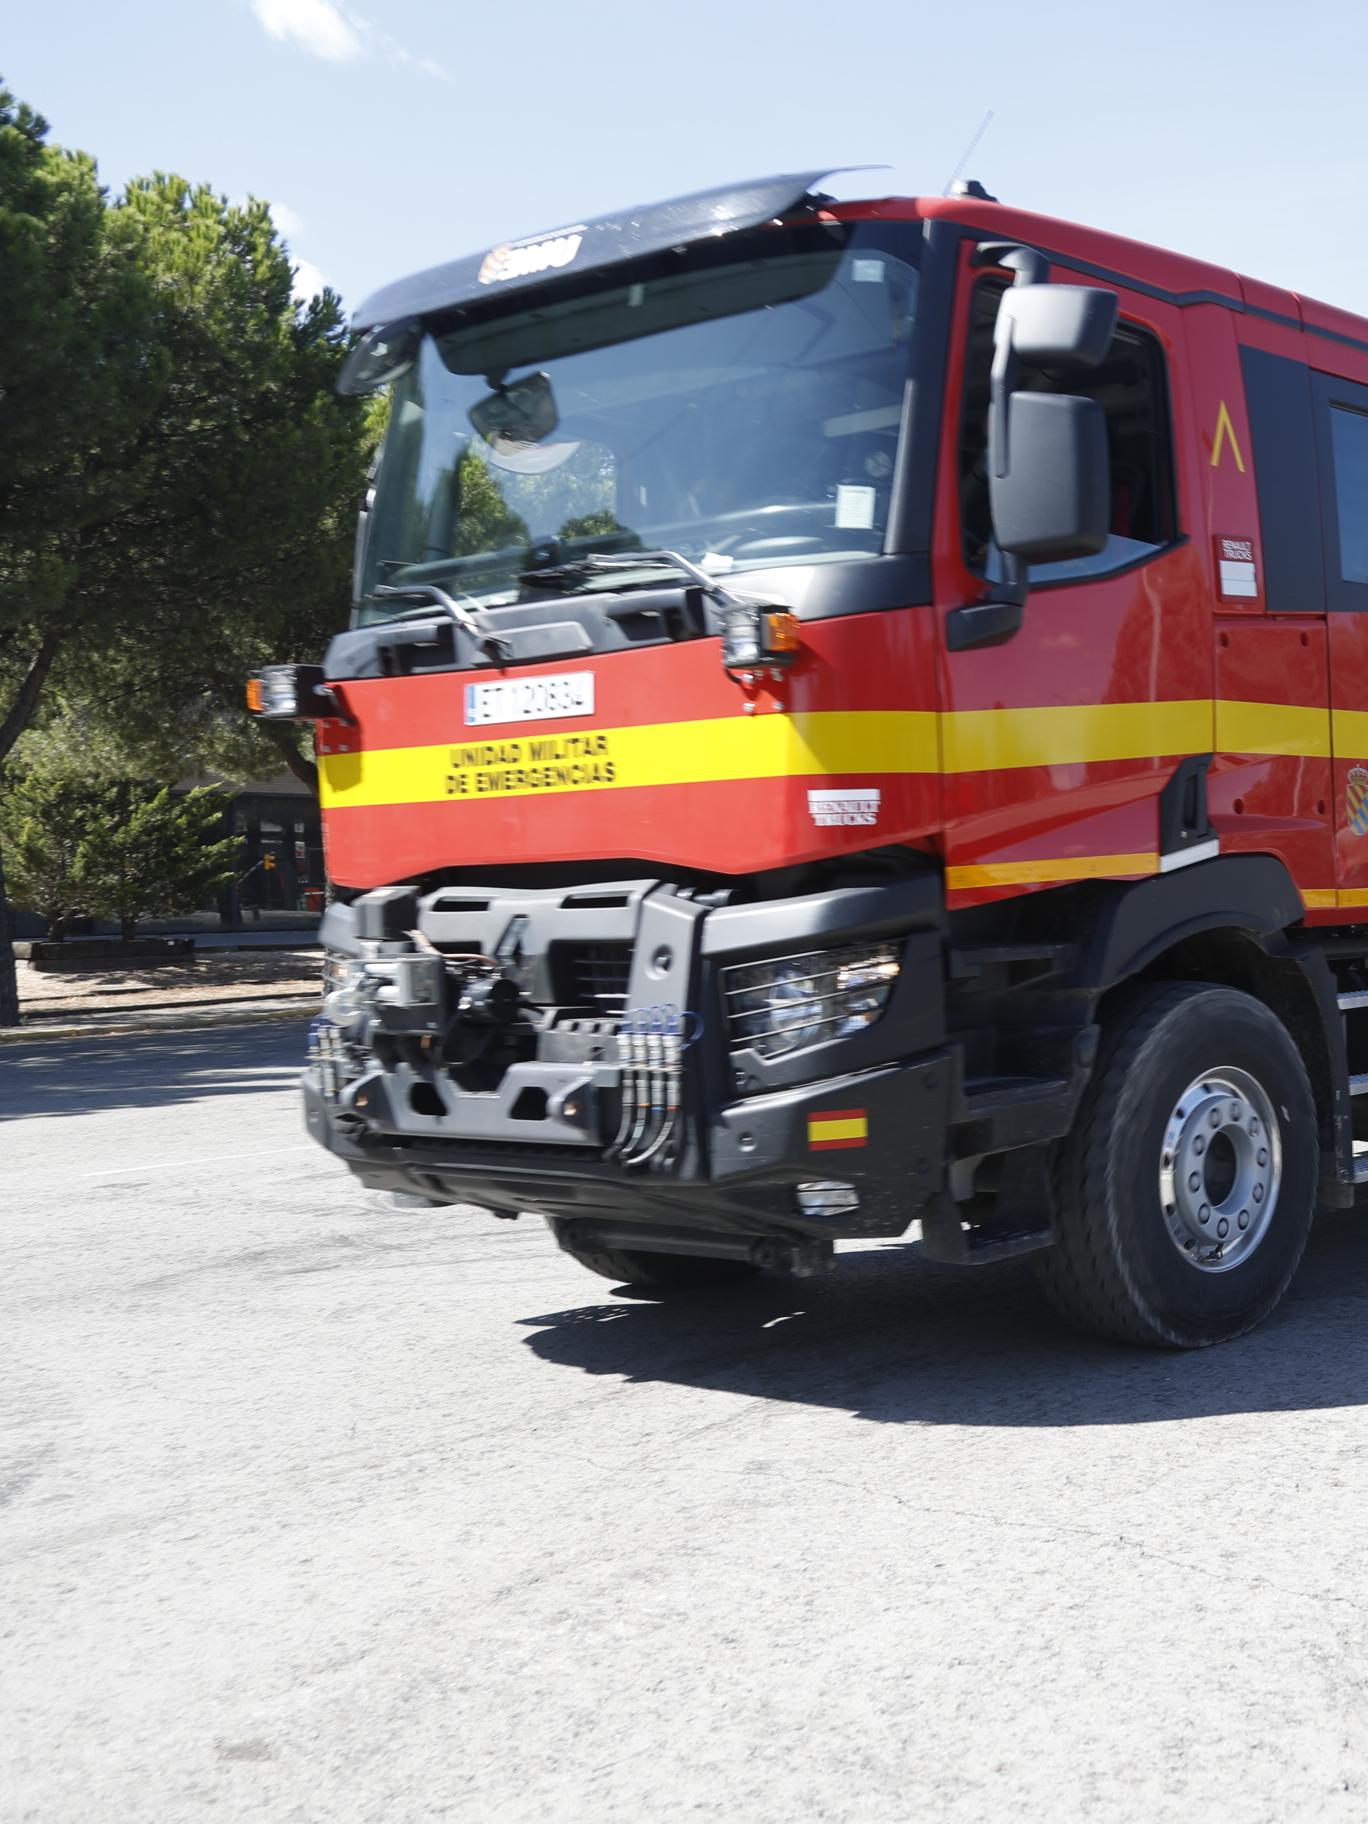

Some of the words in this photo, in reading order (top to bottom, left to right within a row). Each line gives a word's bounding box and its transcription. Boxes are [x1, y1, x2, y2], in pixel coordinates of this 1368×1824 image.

[449, 742, 523, 769] UNIDAD
[528, 735, 610, 762] MILITAR
[446, 774, 469, 794] DE
[475, 761, 617, 793] EMERGENCIAS
